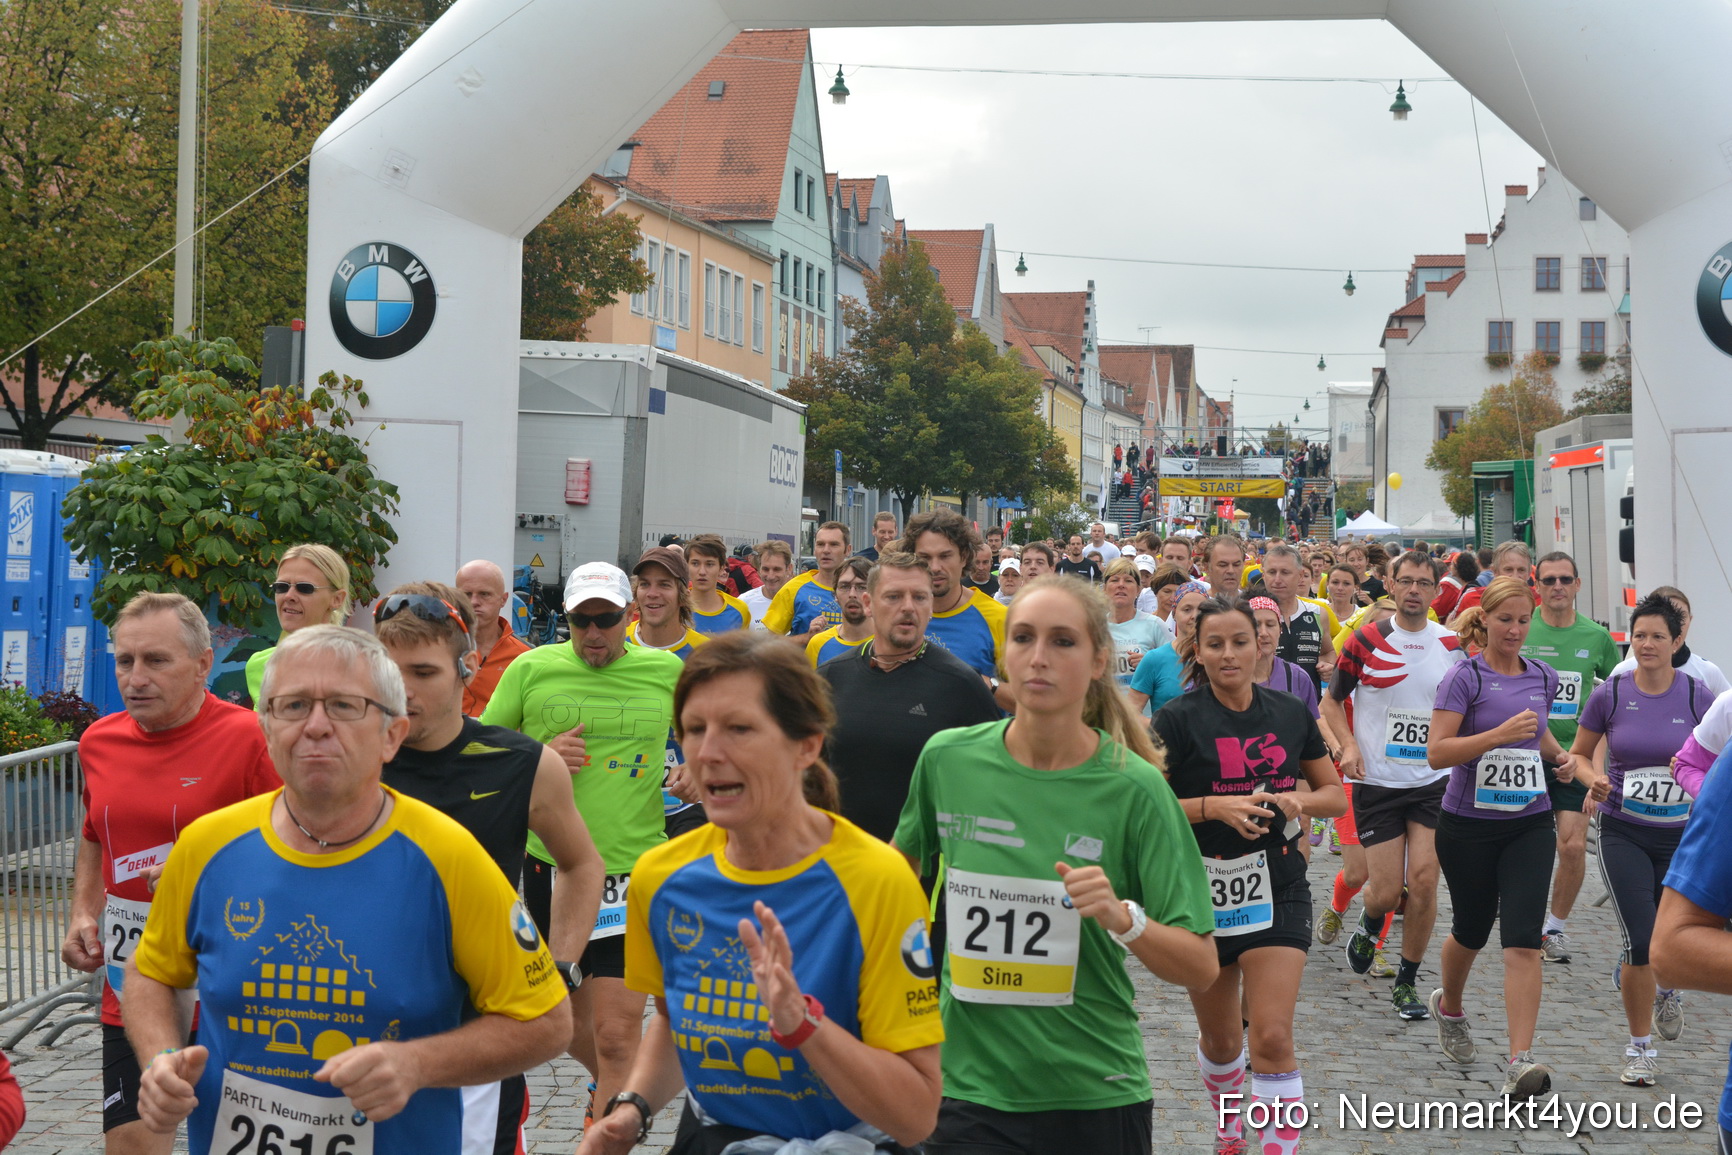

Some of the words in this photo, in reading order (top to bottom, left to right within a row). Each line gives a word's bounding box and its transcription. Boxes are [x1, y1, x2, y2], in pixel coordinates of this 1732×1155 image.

[337, 244, 429, 284] BMW
[1707, 254, 1732, 280] B
[769, 444, 798, 487] BOCK
[1200, 482, 1243, 493] START
[1389, 712, 1408, 720] PARTL
[1392, 722, 1429, 744] 263
[1484, 764, 1537, 788] 2481
[1493, 792, 1529, 803] Kristina
[1644, 806, 1668, 816] Anita
[128, 854, 157, 872] DEHN
[1215, 863, 1254, 876] Neumarkt
[948, 882, 986, 899] PARTL
[989, 889, 1056, 906] Neumarkt
[1211, 872, 1263, 907] 392
[106, 904, 131, 921] PARTL
[239, 902, 250, 911] 15
[232, 914, 255, 924] Jahre
[964, 905, 1051, 957] 212
[982, 966, 1023, 987] Sina
[245, 1005, 330, 1023] 21.September
[334, 1012, 364, 1024] 2014
[681, 1017, 756, 1040] 21.September
[224, 1086, 266, 1112] PARTL
[270, 1104, 344, 1127] Neumarkt
